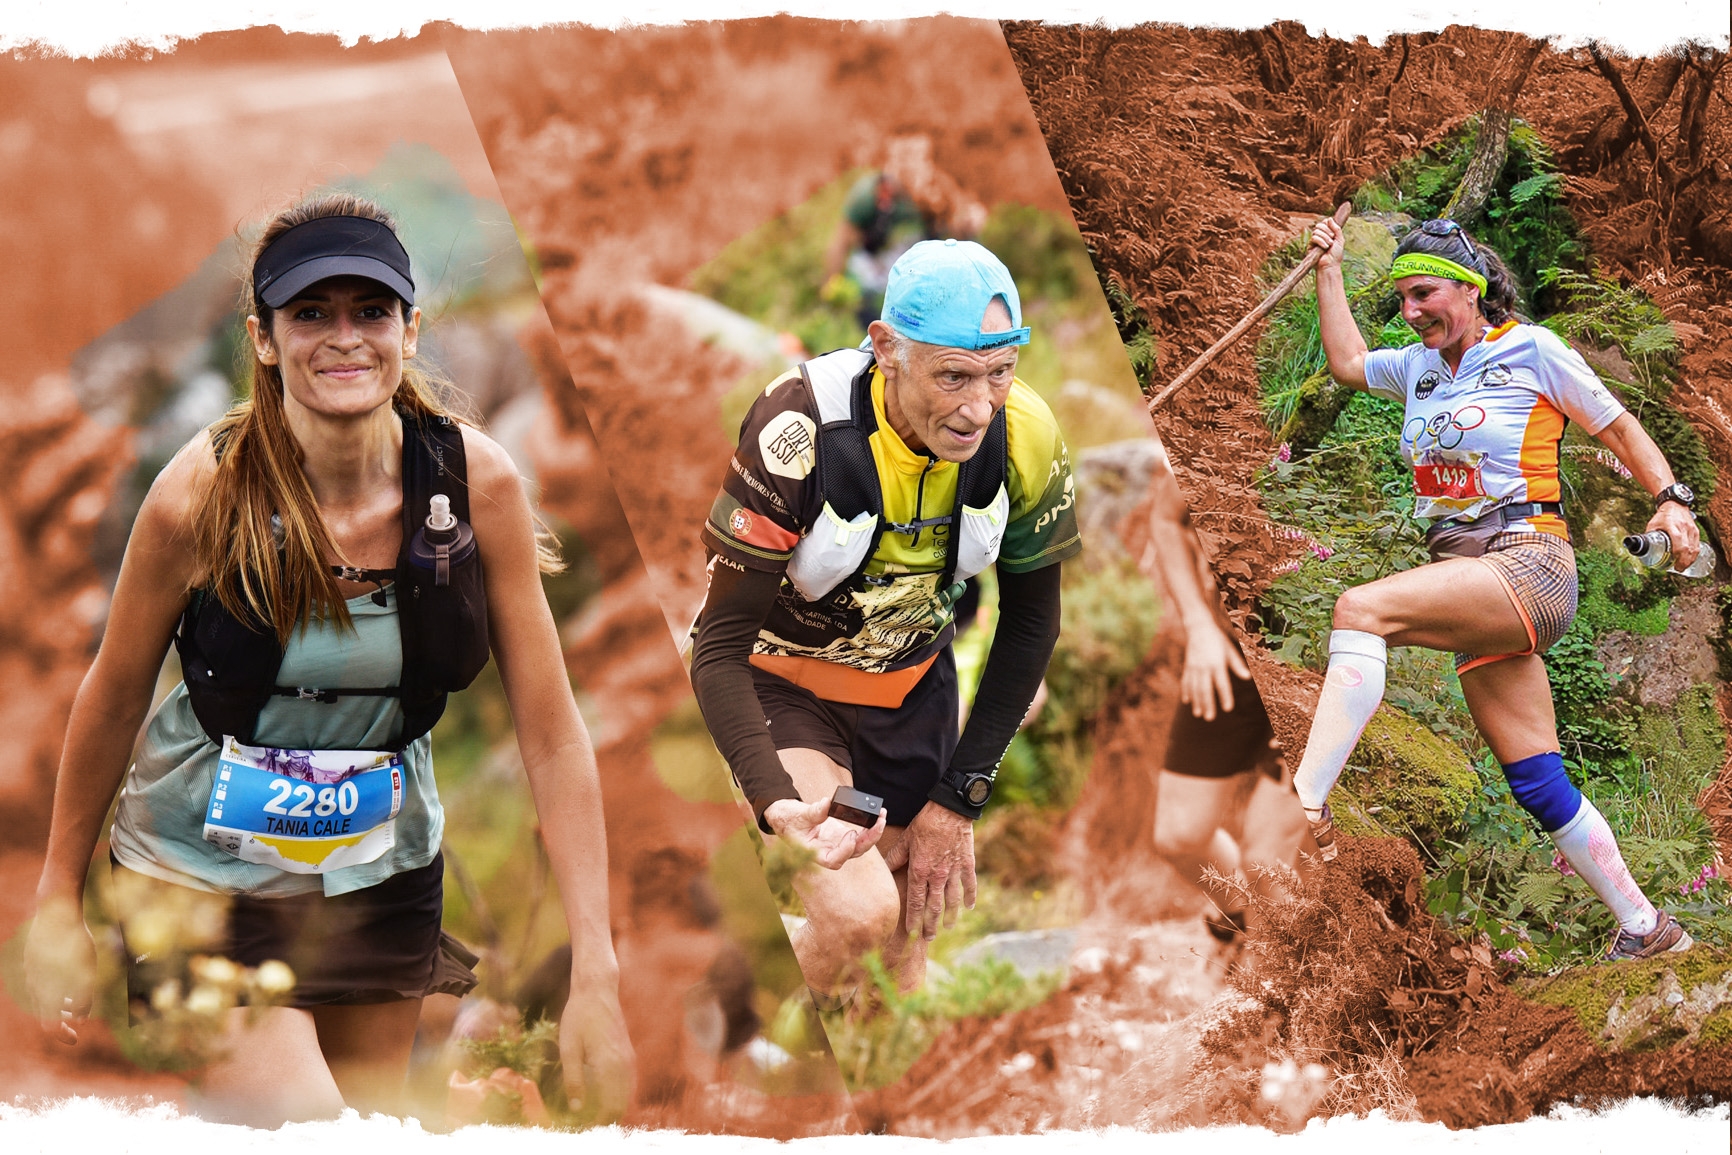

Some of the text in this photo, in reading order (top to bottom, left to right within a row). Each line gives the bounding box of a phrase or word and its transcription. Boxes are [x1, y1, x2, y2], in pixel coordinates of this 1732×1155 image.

[767, 434, 797, 465] ISSO
[263, 778, 358, 817] 2280
[266, 817, 351, 835] TANIA CALE
